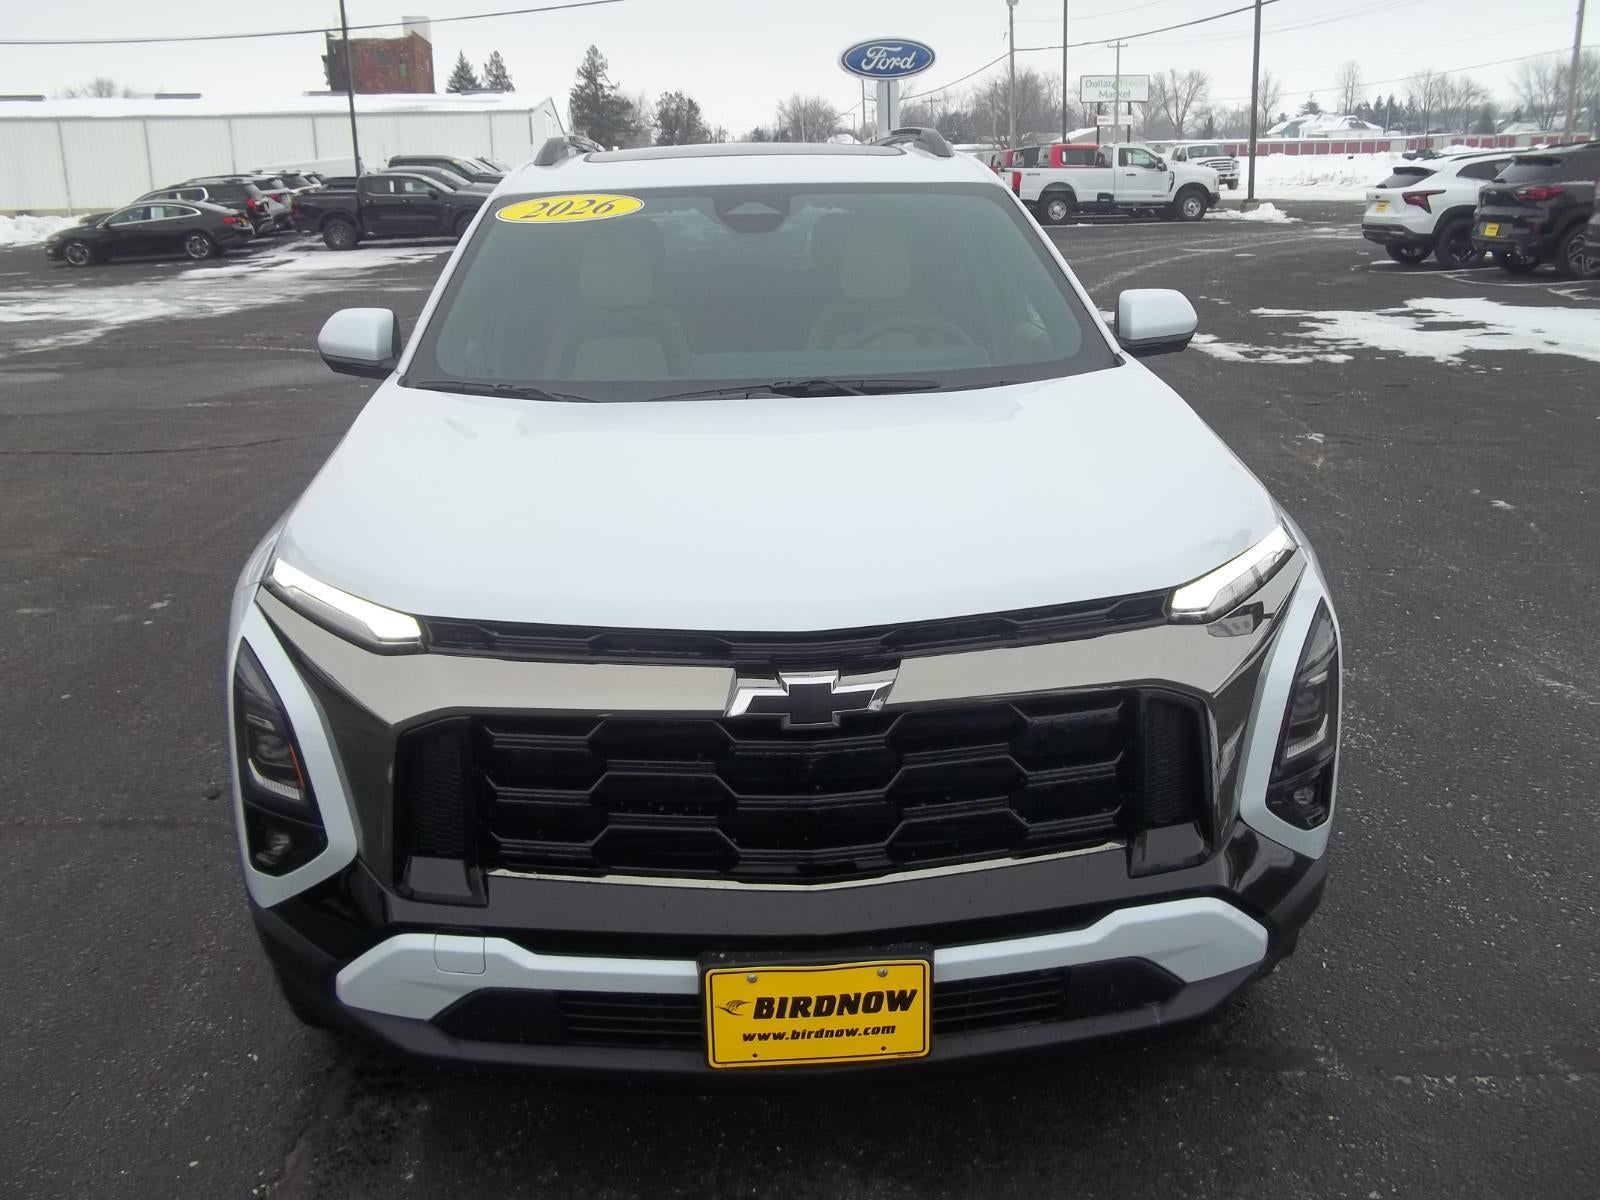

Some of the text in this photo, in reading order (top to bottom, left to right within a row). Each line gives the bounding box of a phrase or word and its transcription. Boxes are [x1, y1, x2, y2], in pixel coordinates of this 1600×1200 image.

[861, 46, 917, 70] Ford
[1085, 80, 1112, 88] Dollar
[520, 198, 621, 219] 2026
[752, 988, 918, 1020] BIRDNOW
[742, 1023, 896, 1042] www.birdnow.com
